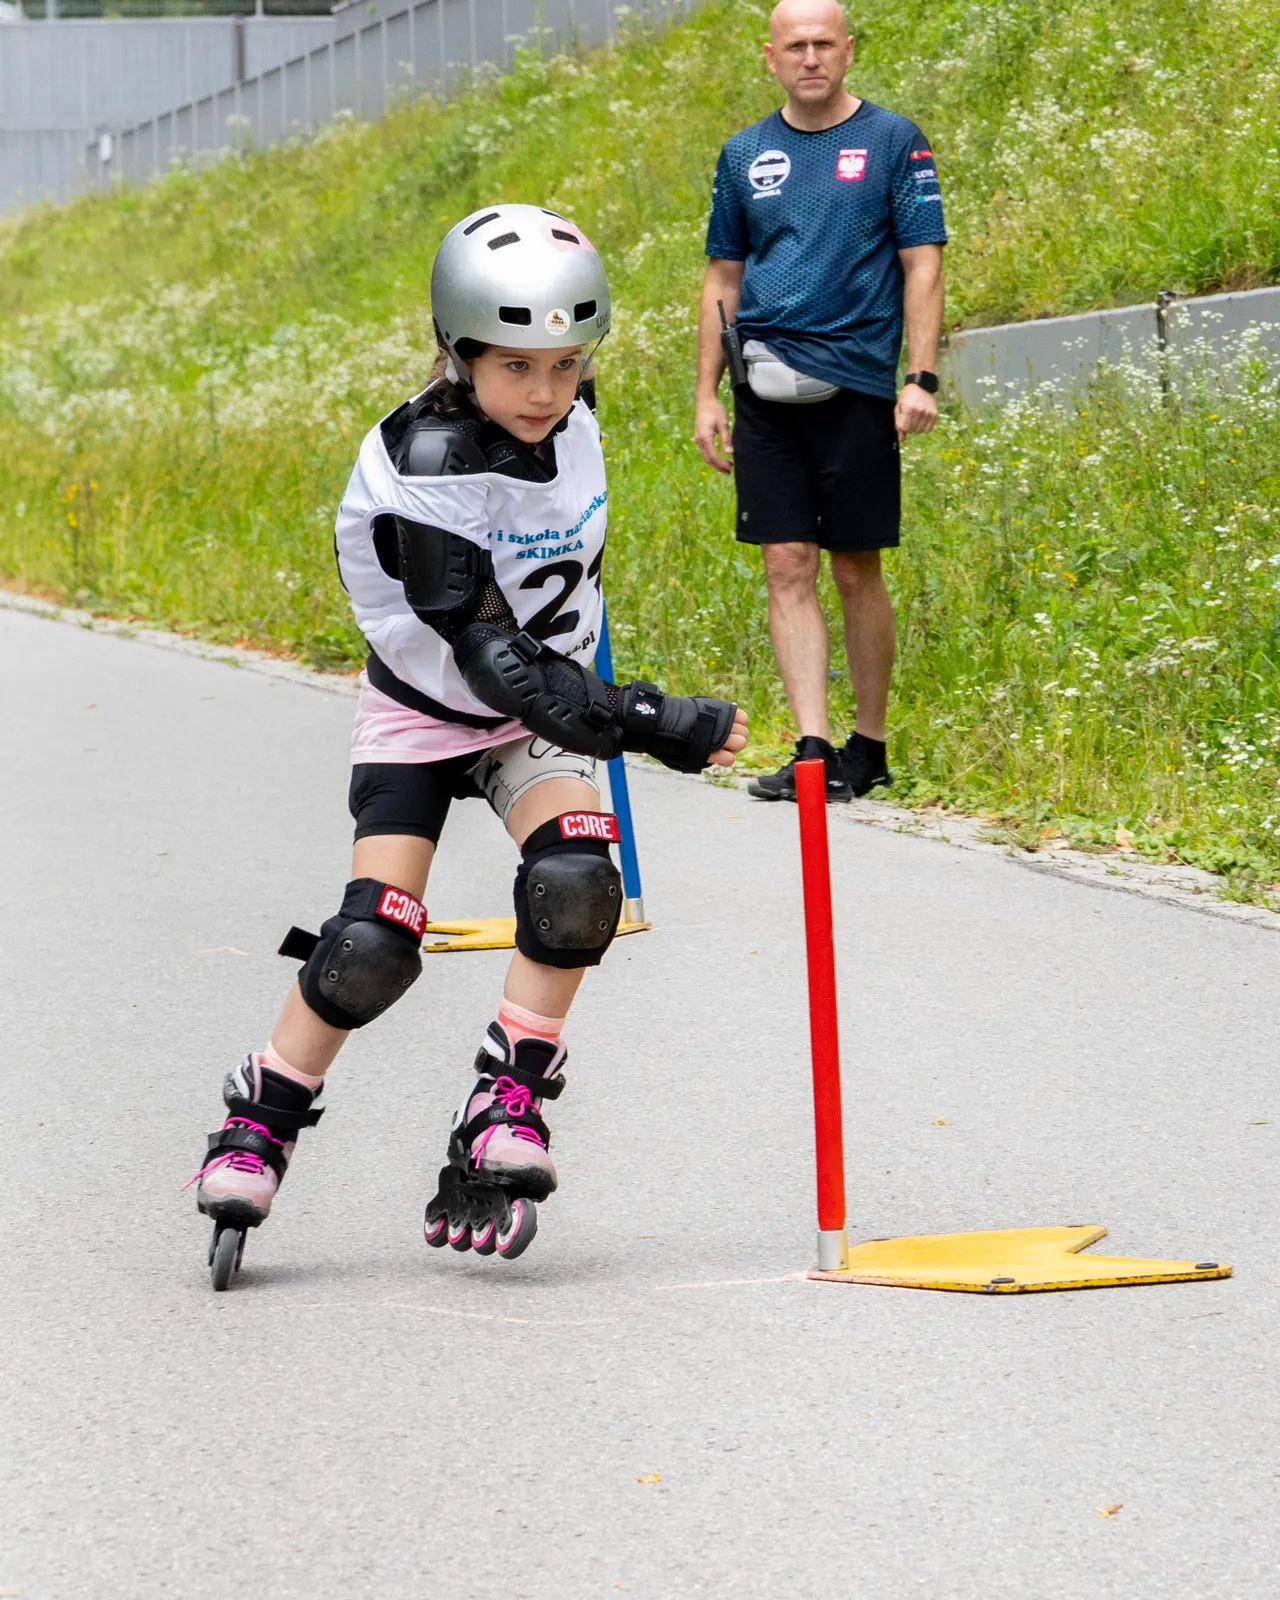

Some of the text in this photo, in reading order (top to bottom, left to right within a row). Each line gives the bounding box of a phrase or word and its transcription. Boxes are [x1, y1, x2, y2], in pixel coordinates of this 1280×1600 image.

[516, 539, 584, 559] SKIMKA
[562, 815, 613, 839] CORE
[381, 890, 425, 933] CORE
